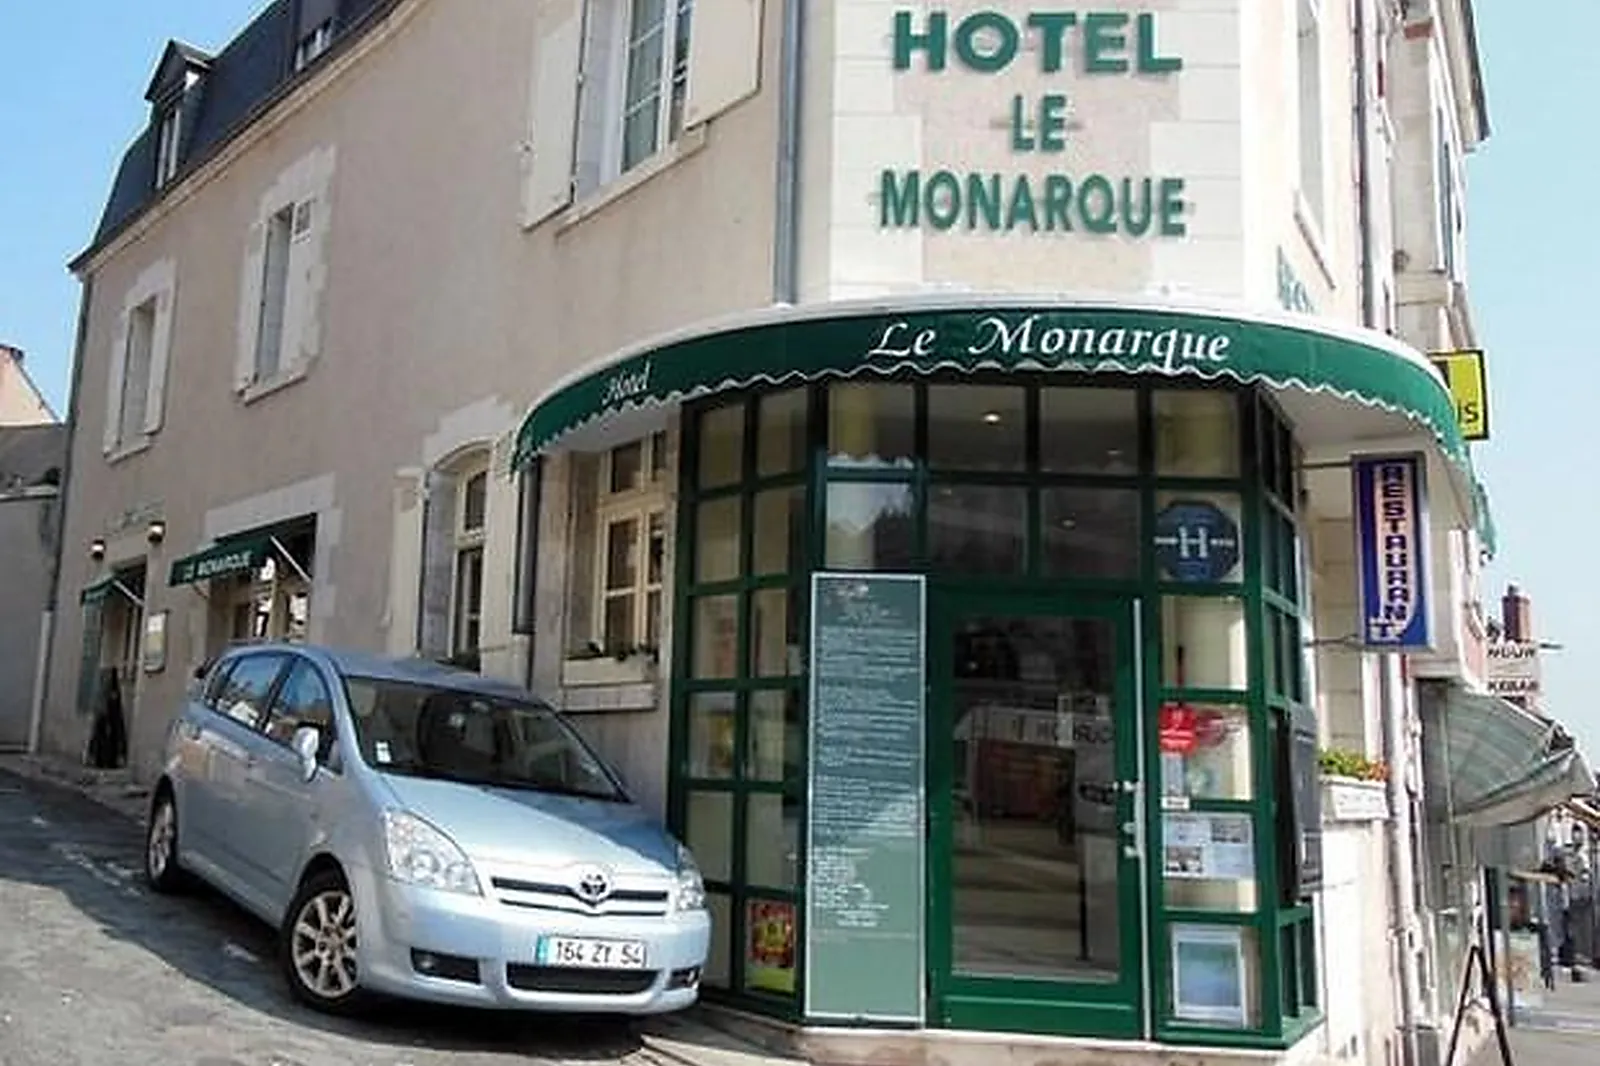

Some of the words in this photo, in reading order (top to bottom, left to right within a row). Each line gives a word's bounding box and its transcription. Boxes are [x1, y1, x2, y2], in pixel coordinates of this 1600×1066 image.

[893, 11, 1182, 73] HOTEL
[1012, 94, 1066, 151] LE
[880, 170, 1187, 236] MONARQUE
[868, 322, 936, 357] Le
[968, 315, 1230, 371] Monarque
[1179, 527, 1208, 558] H
